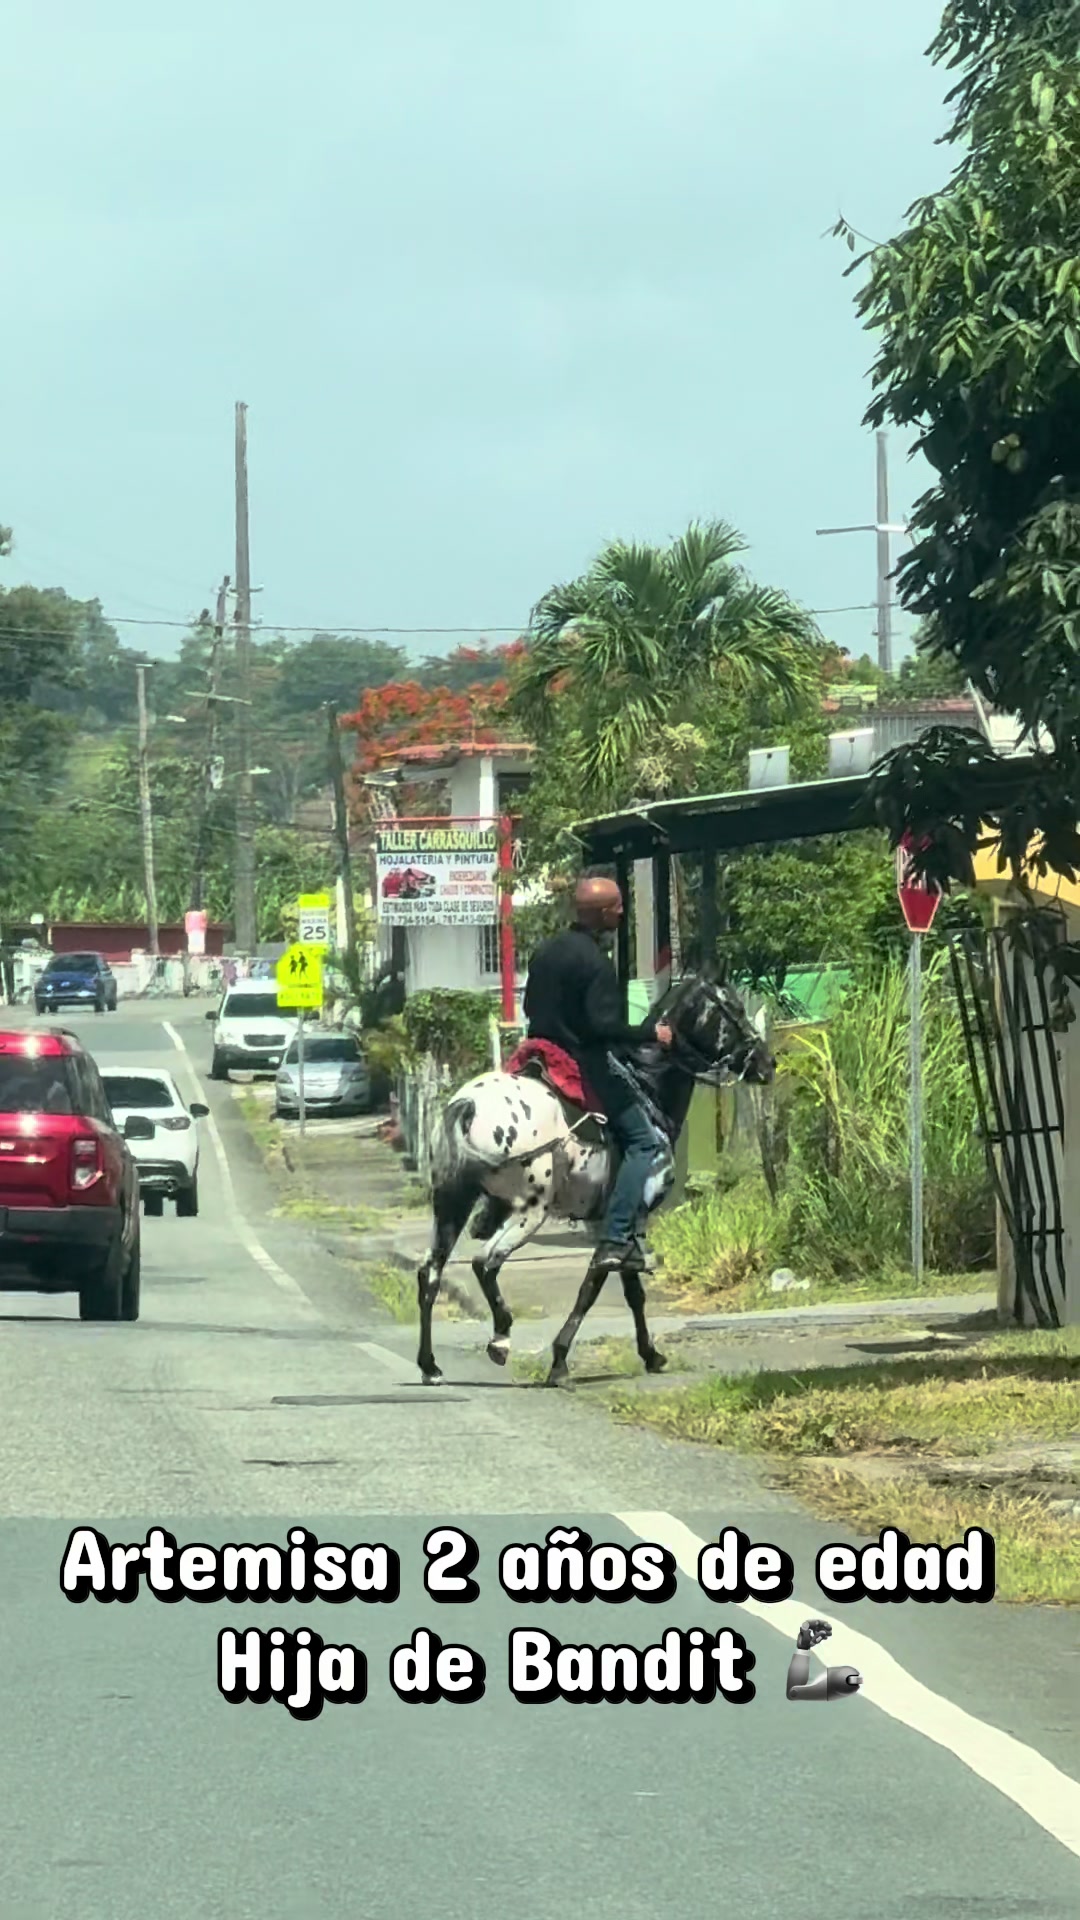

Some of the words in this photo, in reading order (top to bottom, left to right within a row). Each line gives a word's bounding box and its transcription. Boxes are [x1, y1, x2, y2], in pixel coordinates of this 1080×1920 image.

[380, 832, 417, 850] TALLER
[419, 831, 497, 850] CARRASQUILLO
[379, 855, 443, 866] HOJALATERIA
[446, 855, 453, 865] Y
[454, 854, 495, 865] PINTURA
[303, 926, 326, 940] 25
